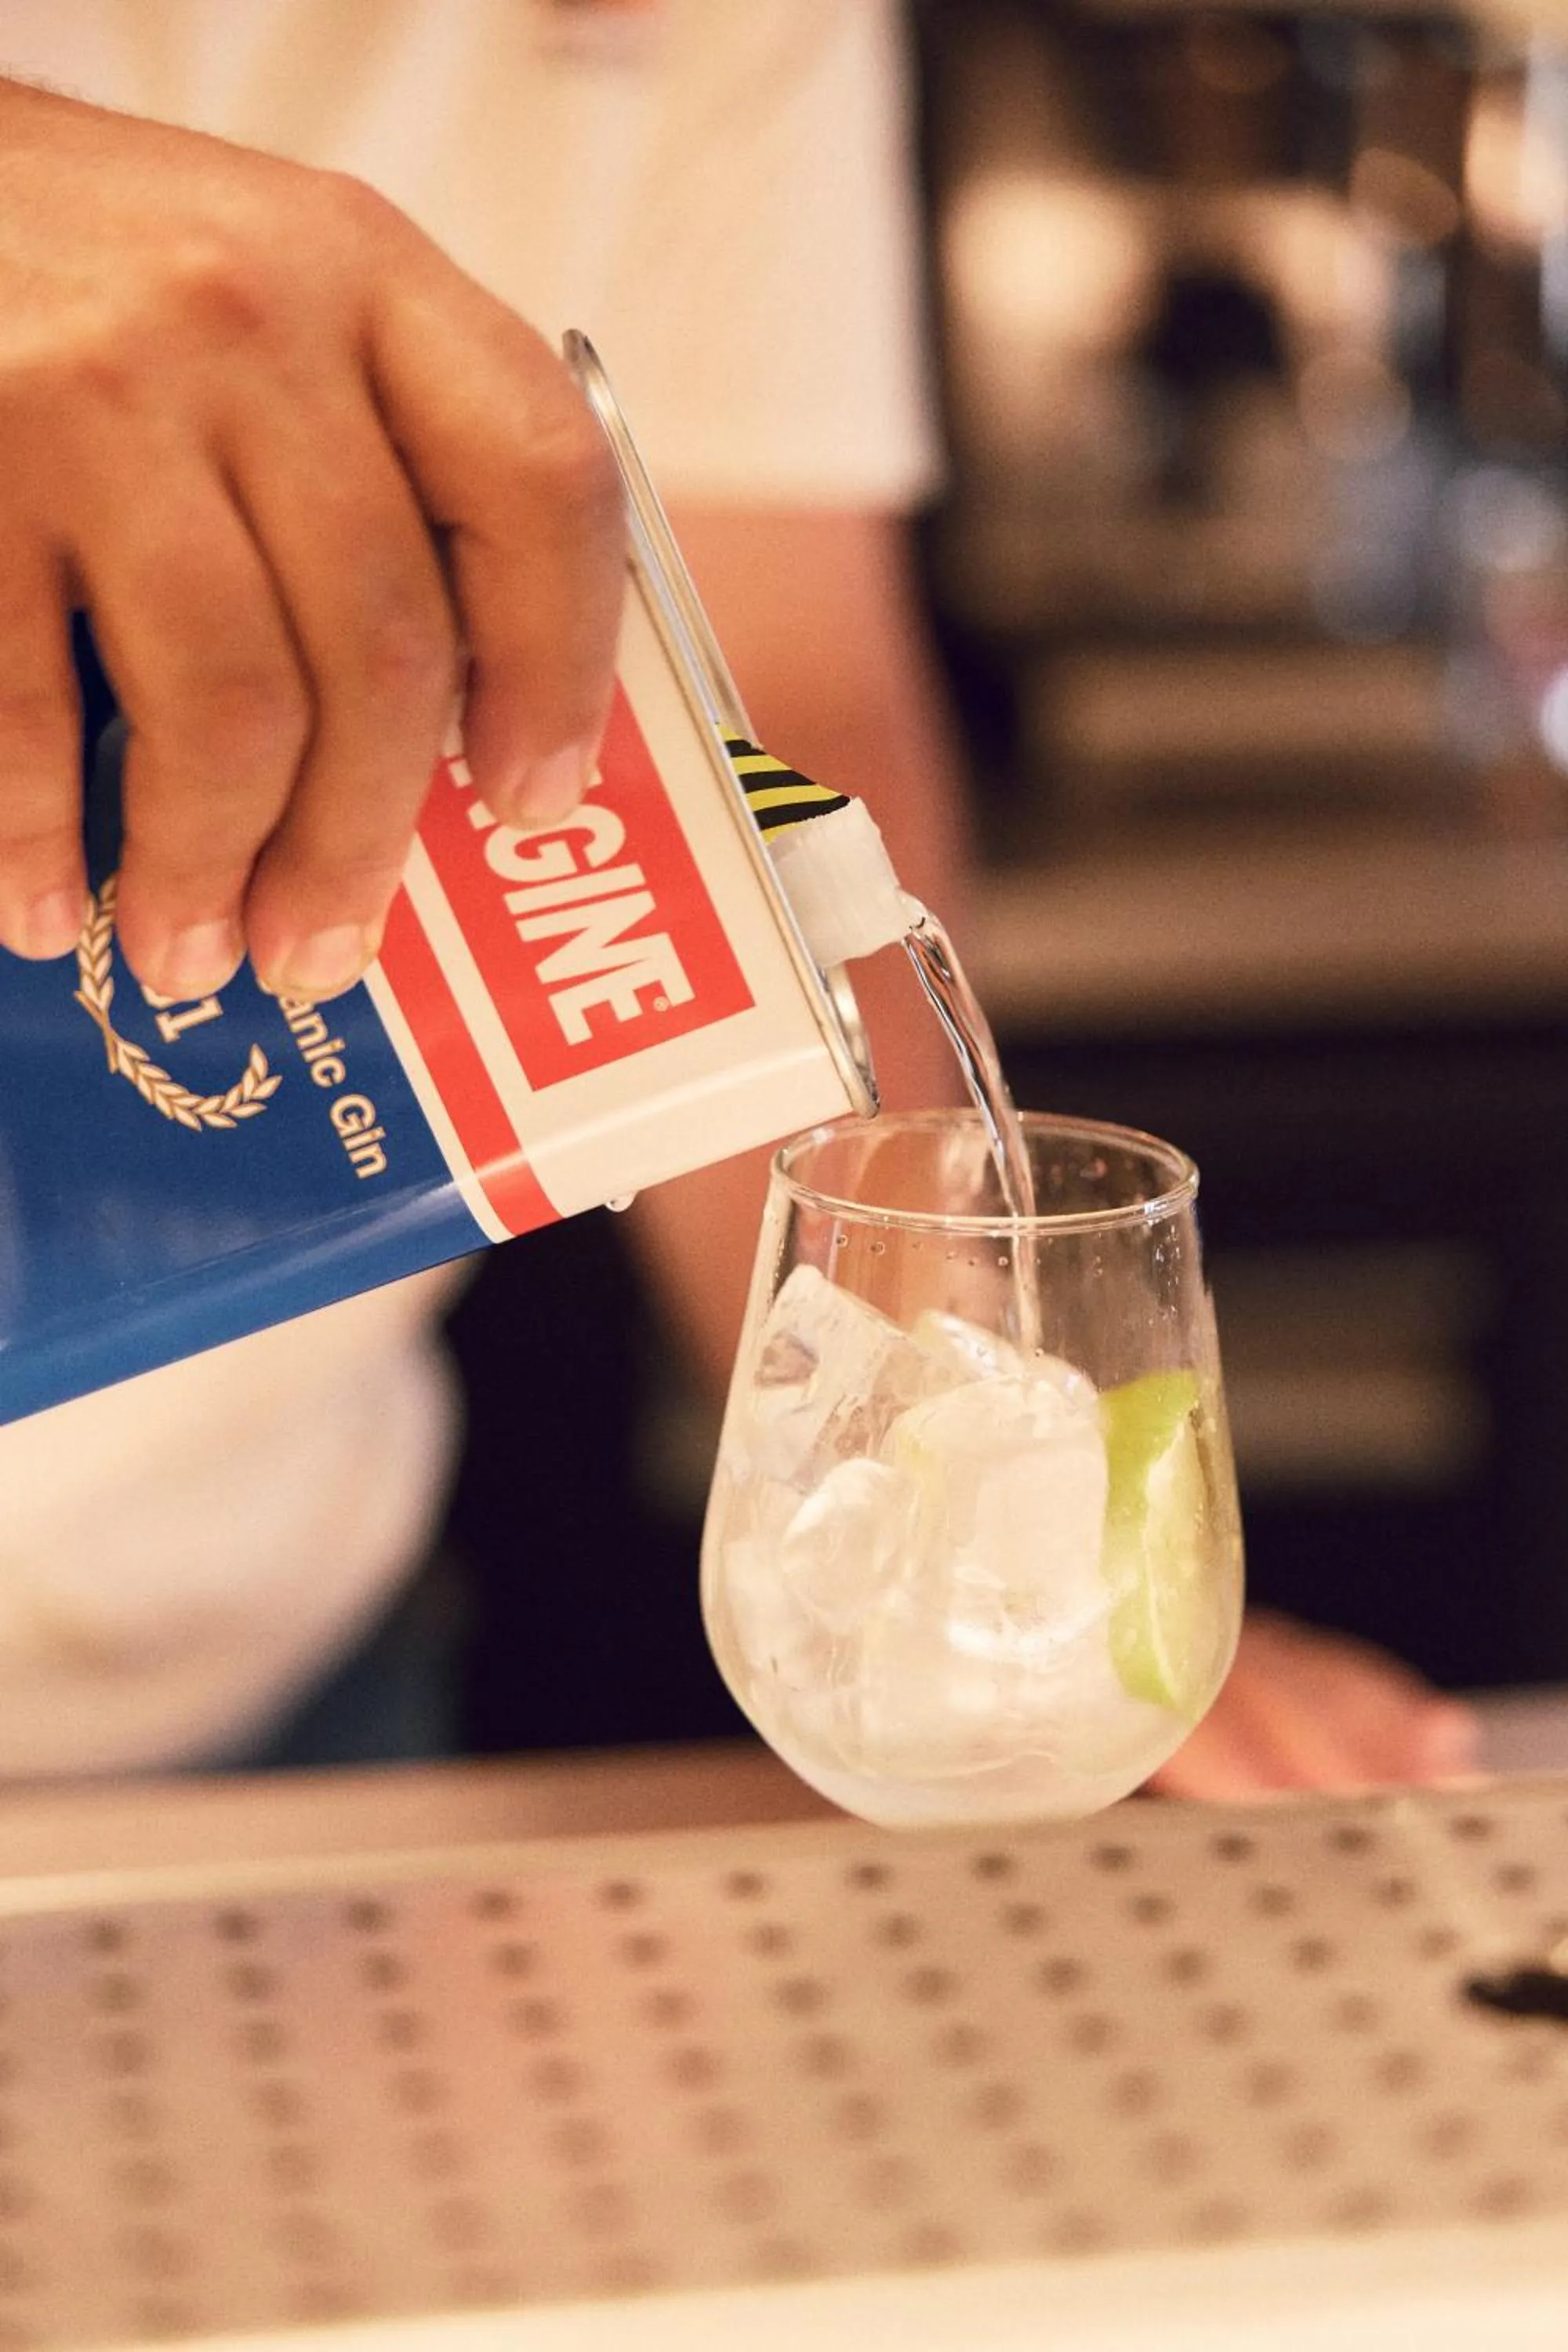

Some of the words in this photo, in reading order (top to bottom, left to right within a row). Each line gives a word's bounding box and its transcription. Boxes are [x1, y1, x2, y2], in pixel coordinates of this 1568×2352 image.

[443, 733, 695, 1046] GINE
[277, 994, 347, 1088] anic
[328, 1093, 388, 1179] Gin
